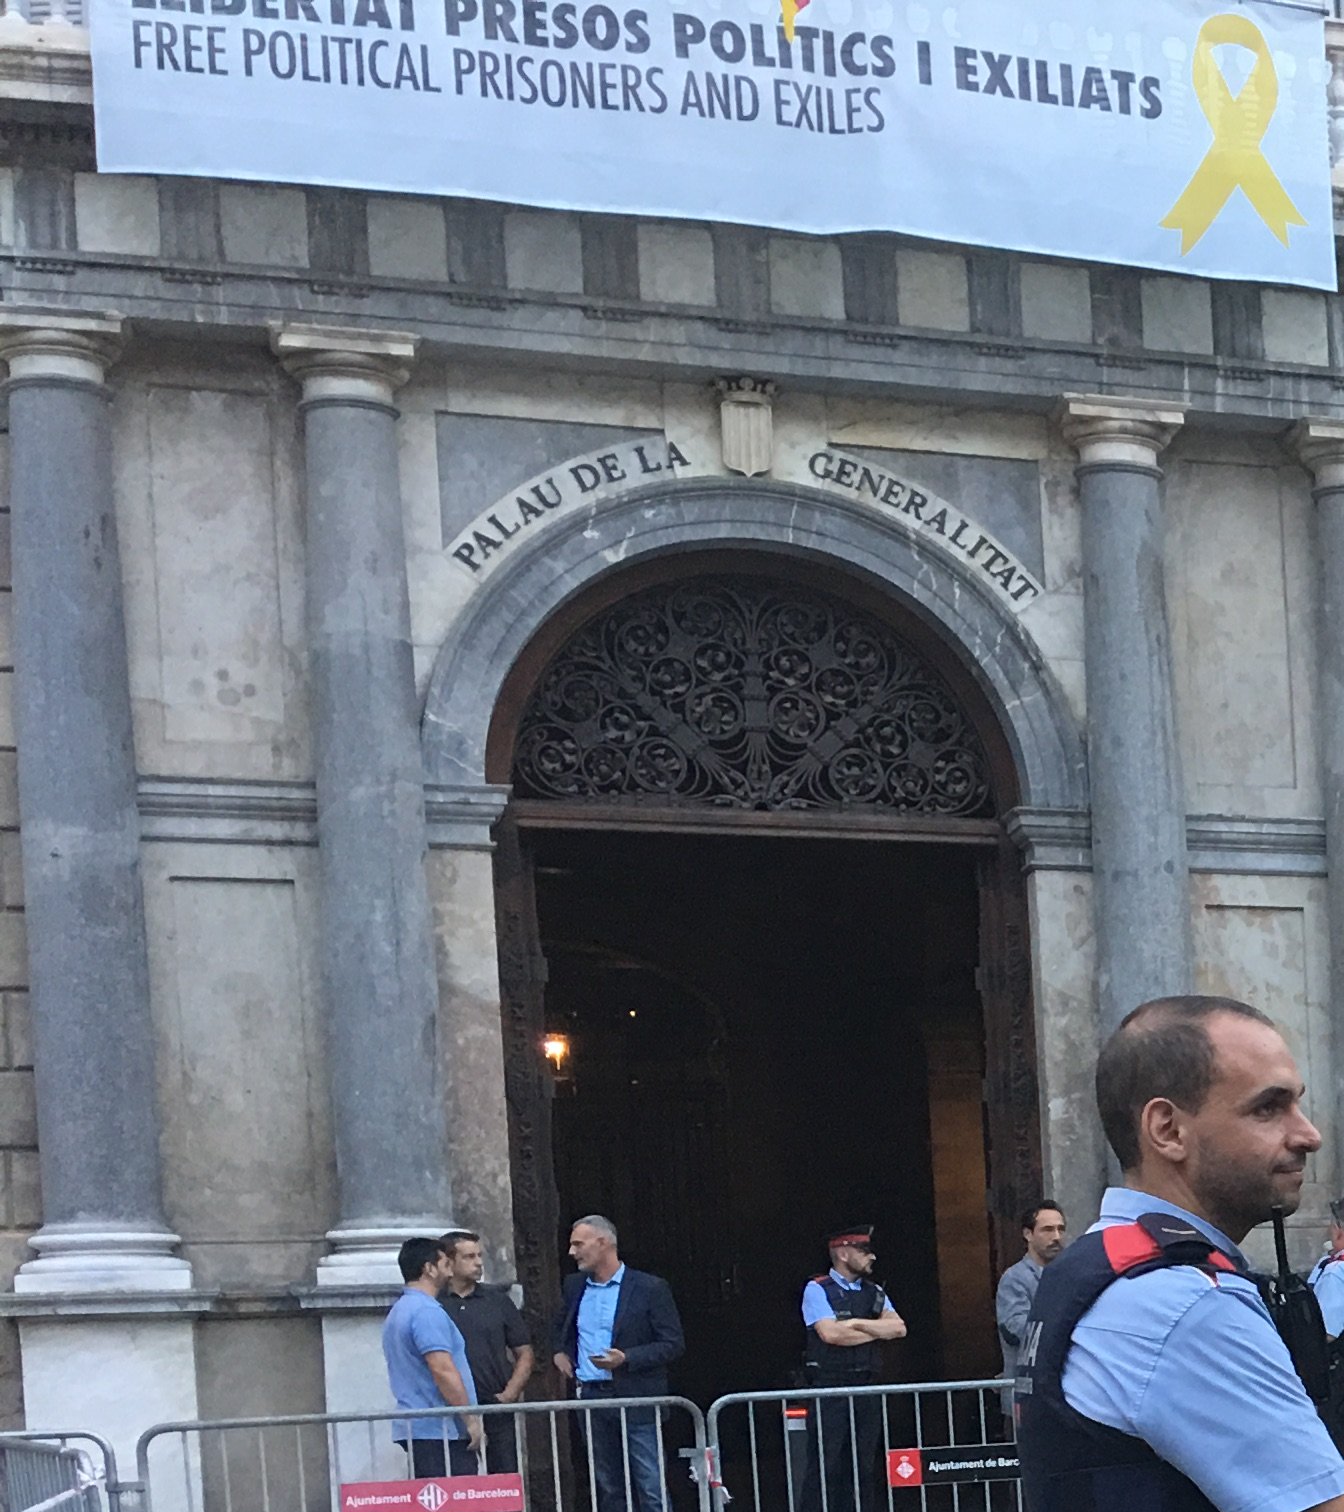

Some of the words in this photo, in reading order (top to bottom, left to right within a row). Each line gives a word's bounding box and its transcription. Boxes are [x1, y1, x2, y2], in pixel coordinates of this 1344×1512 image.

[133, 20, 228, 76] FREE
[242, 28, 442, 93] POLITICAL
[453, 48, 668, 114] PRISONERS
[680, 70, 760, 122] AND
[773, 79, 885, 135] EXILES
[445, 0, 651, 54] PRESOS
[917, 41, 932, 85] I
[954, 46, 1163, 120] EXILIATS
[452, 477, 563, 573] PALAU
[569, 453, 627, 493] DE
[634, 441, 691, 475] LA
[808, 452, 1039, 602] GENERALITAT
[346, 1493, 412, 1508] Ajuntament
[453, 1490, 466, 1500] de
[468, 1488, 520, 1500] Barcelona
[928, 1459, 984, 1472] Ajuntament
[985, 1458, 997, 1467] de
